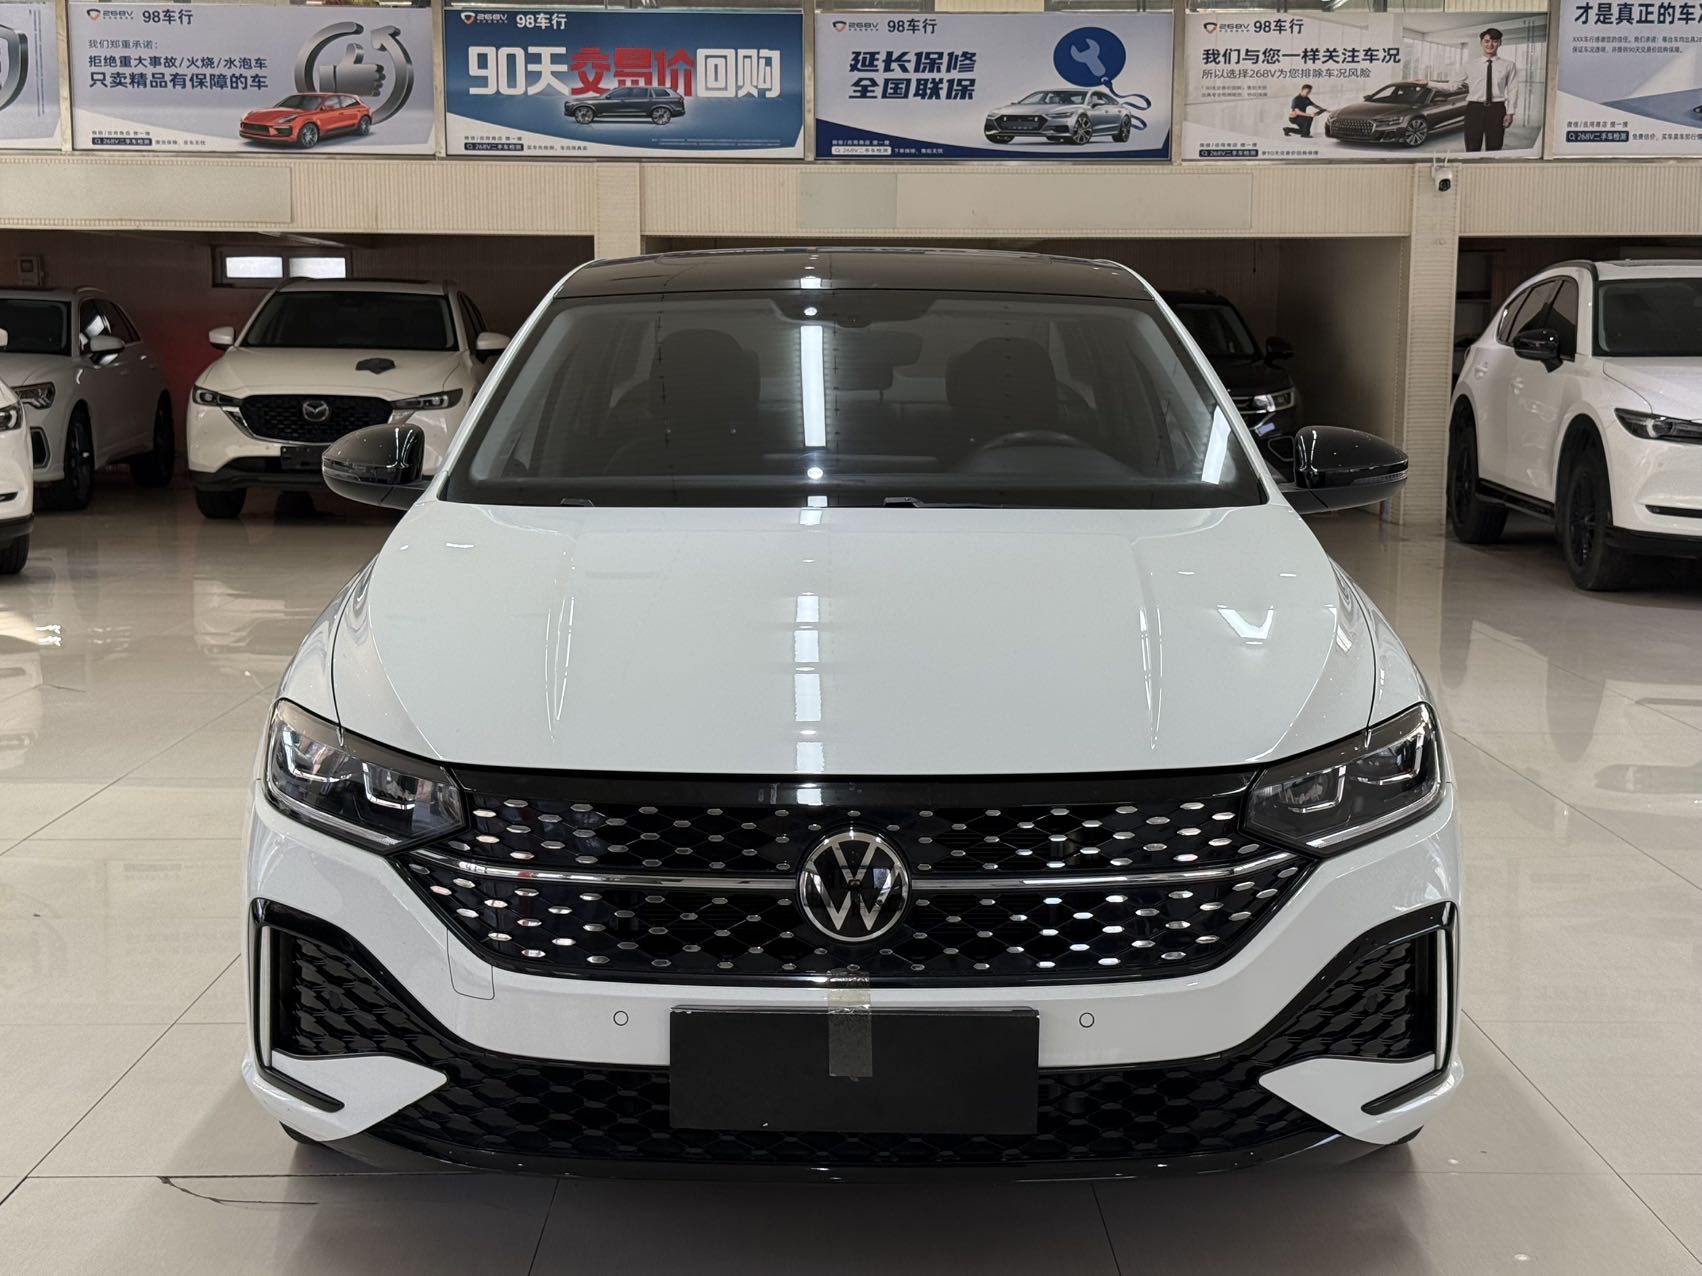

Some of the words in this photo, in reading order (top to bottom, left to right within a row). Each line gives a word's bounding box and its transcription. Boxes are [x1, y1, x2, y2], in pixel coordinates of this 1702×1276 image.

[142, 9, 194, 25] 98车行
[516, 13, 568, 30] 98车行
[887, 18, 937, 35] 98车行
[1253, 18, 1304, 35] 98车行
[88, 55, 268, 70] 拒绝重大事故/火烧/水泡车
[849, 51, 977, 74] 延长保修
[1202, 47, 1401, 65] 我们与您一样关注车况
[468, 46, 781, 98] 90天交易价回购
[1201, 68, 1371, 80] 所以选择268V为您排除车况风险
[89, 72, 269, 90] 只卖精品有保障的车
[848, 77, 976, 100] 全国联保
